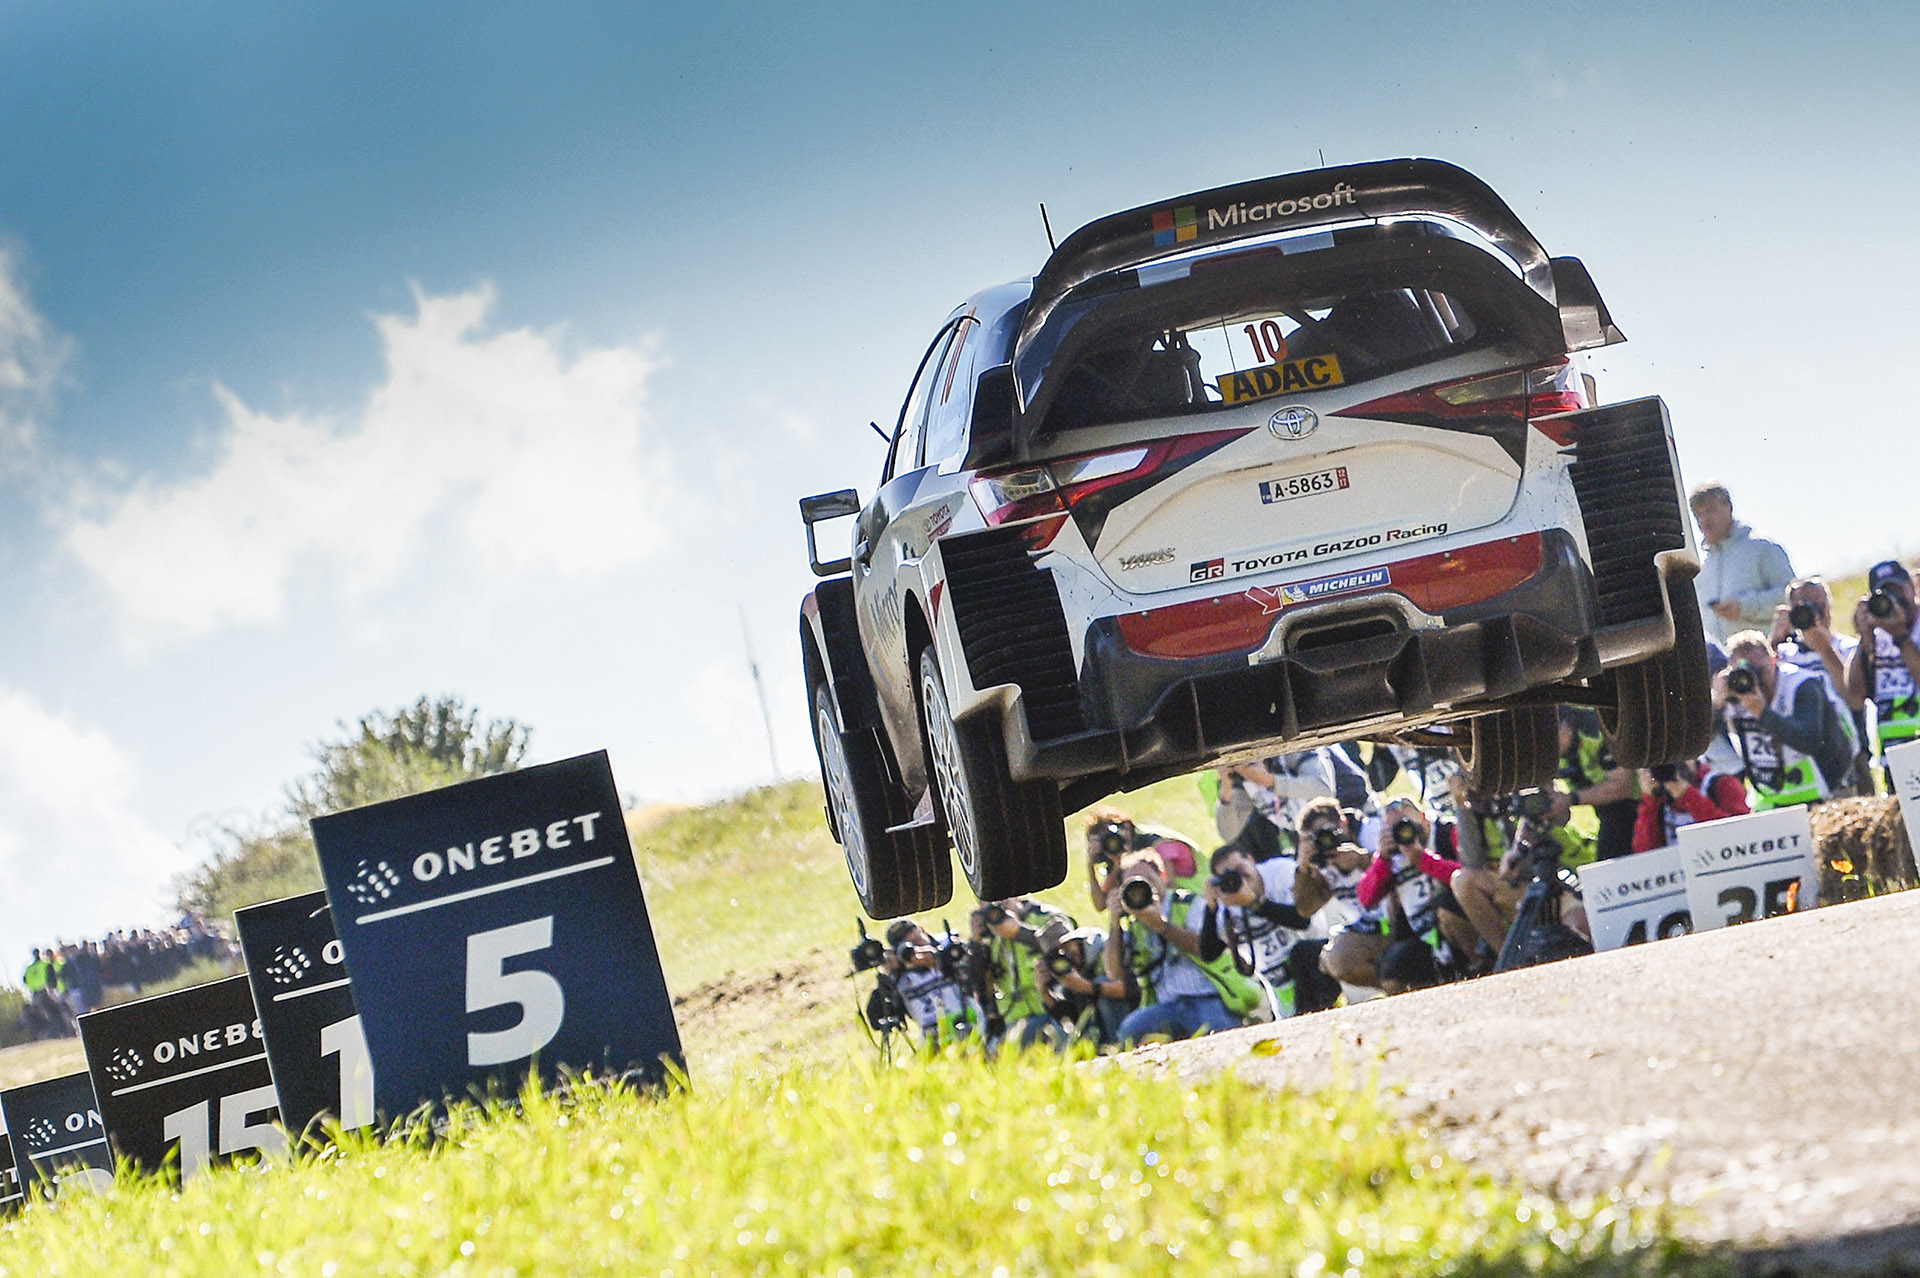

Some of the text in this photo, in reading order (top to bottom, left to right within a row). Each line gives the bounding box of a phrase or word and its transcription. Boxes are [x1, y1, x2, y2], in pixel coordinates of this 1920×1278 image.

[1207, 182, 1356, 230] Microsoft
[1244, 320, 1288, 363] 10
[1232, 358, 1331, 401] ADAC
[1191, 522, 1448, 582] GR TOYOTA GAZOO Racing
[1308, 571, 1384, 595] MICHELIN
[412, 811, 602, 882] ONEBET
[1720, 834, 1800, 861] ONEBET
[464, 915, 565, 1067] 5
[163, 1083, 288, 1194] 15
